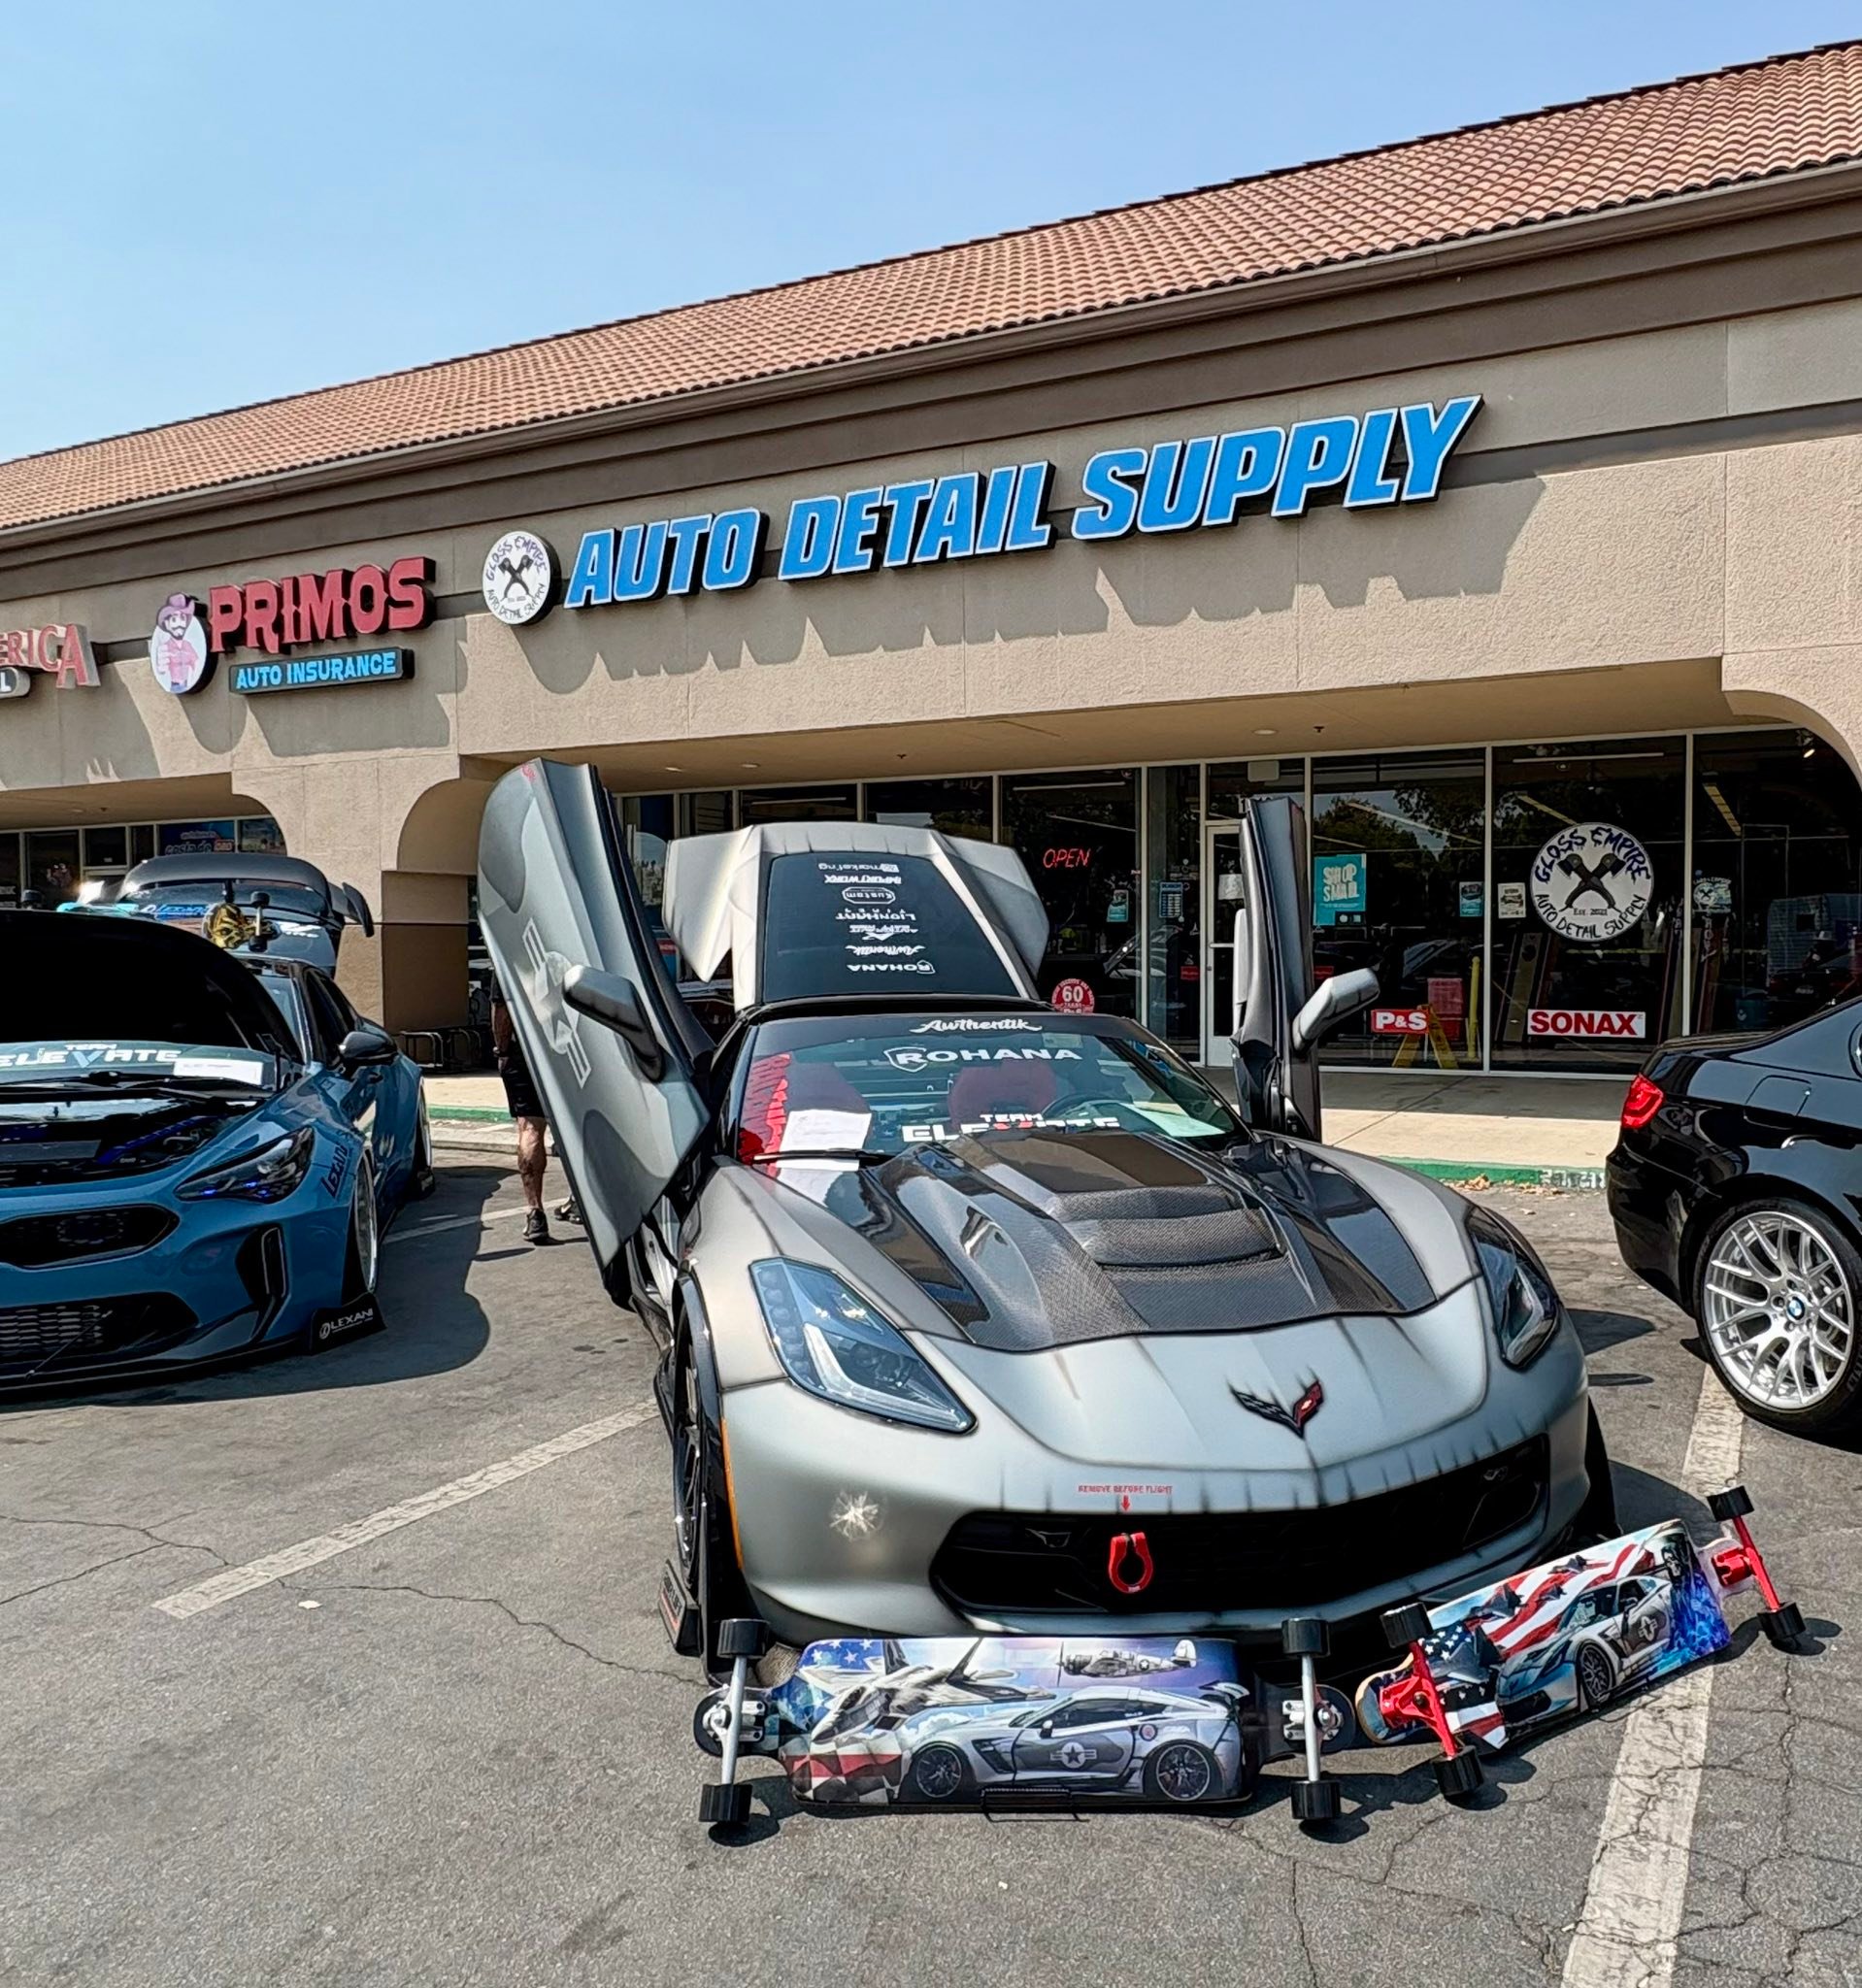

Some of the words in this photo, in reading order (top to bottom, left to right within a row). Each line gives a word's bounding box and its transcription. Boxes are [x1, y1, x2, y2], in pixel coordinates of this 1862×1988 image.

[564, 508, 762, 609] AUTO
[778, 460, 1052, 581] DETAIL
[1071, 394, 1483, 541] SUPPLY
[210, 556, 427, 653] PRIMOS
[236, 665, 283, 689] AUTO
[286, 651, 396, 681] INSURANCE
[1043, 848, 1092, 869] OPEN
[1535, 828, 1586, 884] GLOSS
[1590, 826, 1651, 885] EMPIRE
[1323, 863, 1357, 884] SHOP
[1535, 894, 1558, 923] AUTO
[1556, 916, 1602, 939] DETAIL
[1604, 894, 1646, 935] SUPPLY
[847, 963, 932, 972] ROHANA
[1062, 985, 1083, 1003] 60
[1376, 1011, 1428, 1030] P&S
[1531, 1012, 1638, 1036] SONAX
[895, 1048, 1083, 1066] ROHANA
[980, 1113, 1044, 1123] TEAM
[330, 1308, 374, 1330] LEXANI
[1146, 1485, 1173, 1494] FLIGHT
